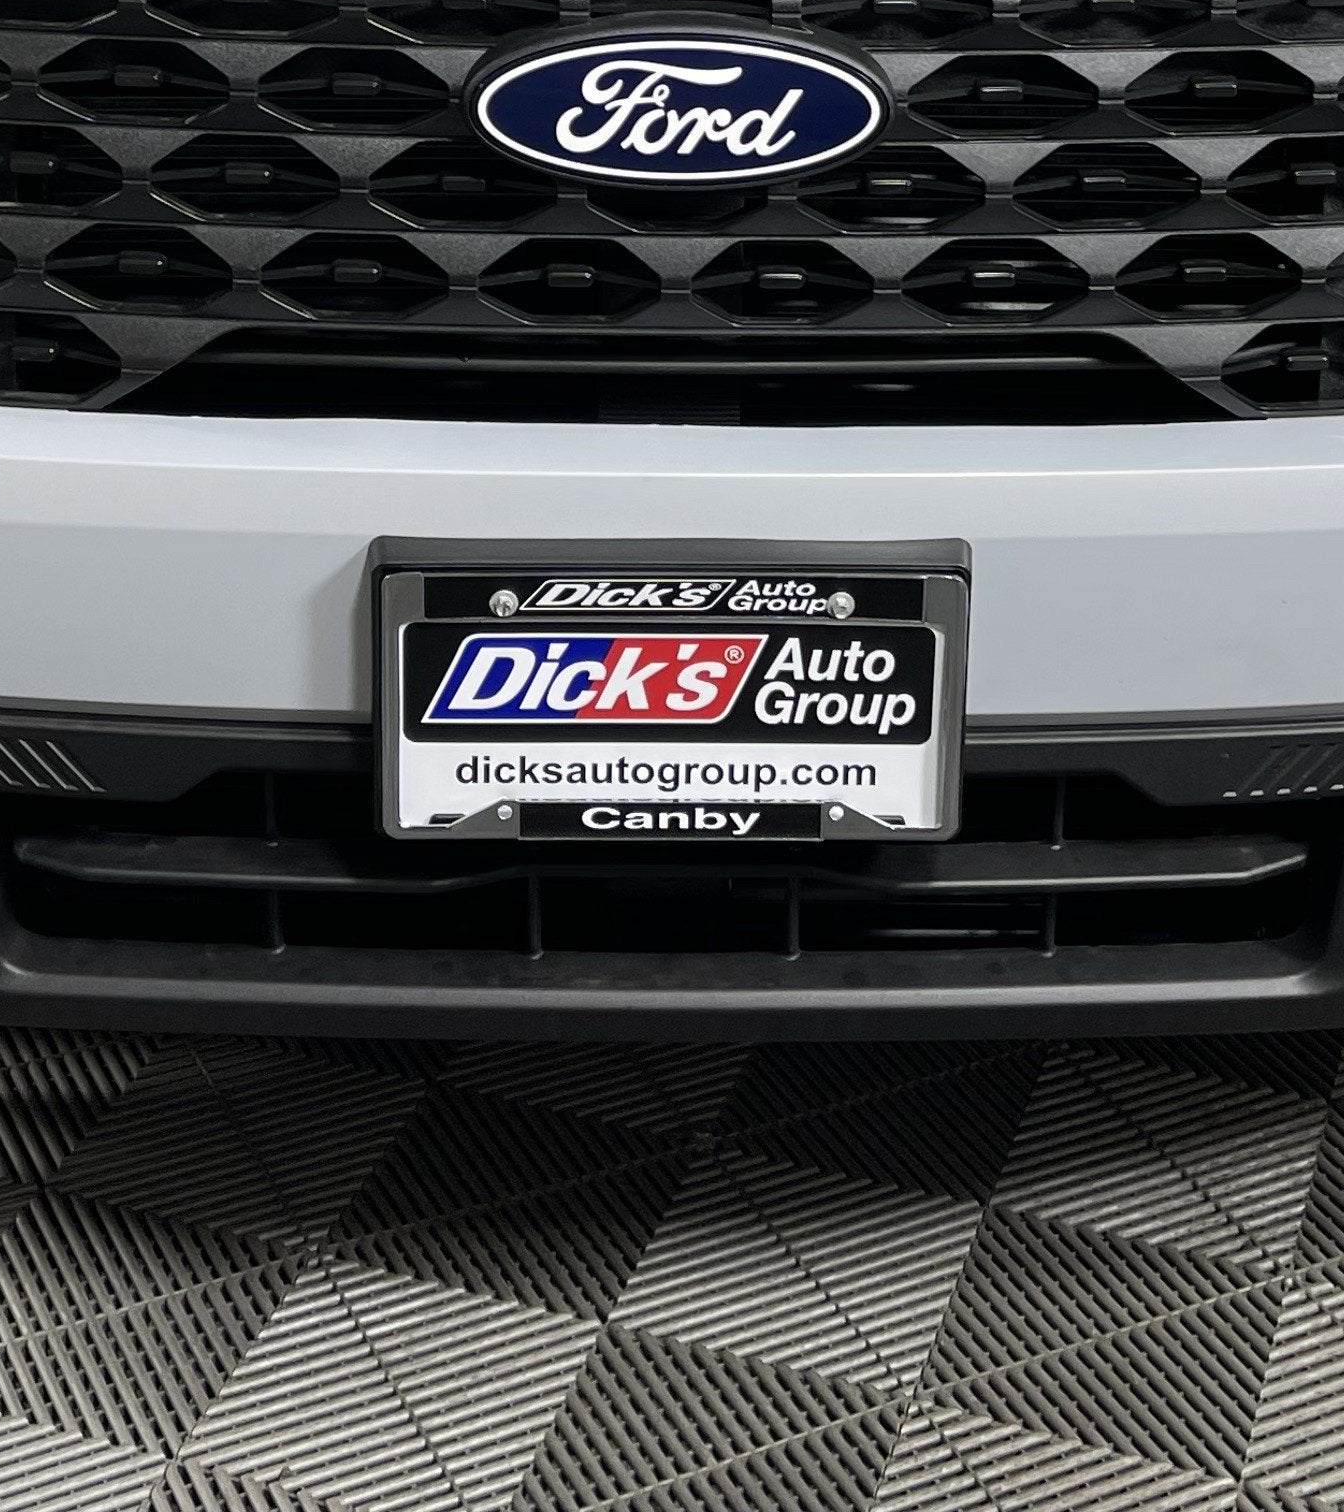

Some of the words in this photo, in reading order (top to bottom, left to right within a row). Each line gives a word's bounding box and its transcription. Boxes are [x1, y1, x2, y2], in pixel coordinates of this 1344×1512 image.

[555, 59, 804, 157] Ford
[534, 581, 712, 607] Dick's
[727, 595, 828, 615] Group
[735, 579, 817, 597] Auto
[447, 642, 728, 712] Dick's
[764, 637, 896, 682] Auto
[754, 681, 916, 735] Group
[455, 755, 877, 792] dicksautogroup.com
[581, 807, 761, 836] Canby
